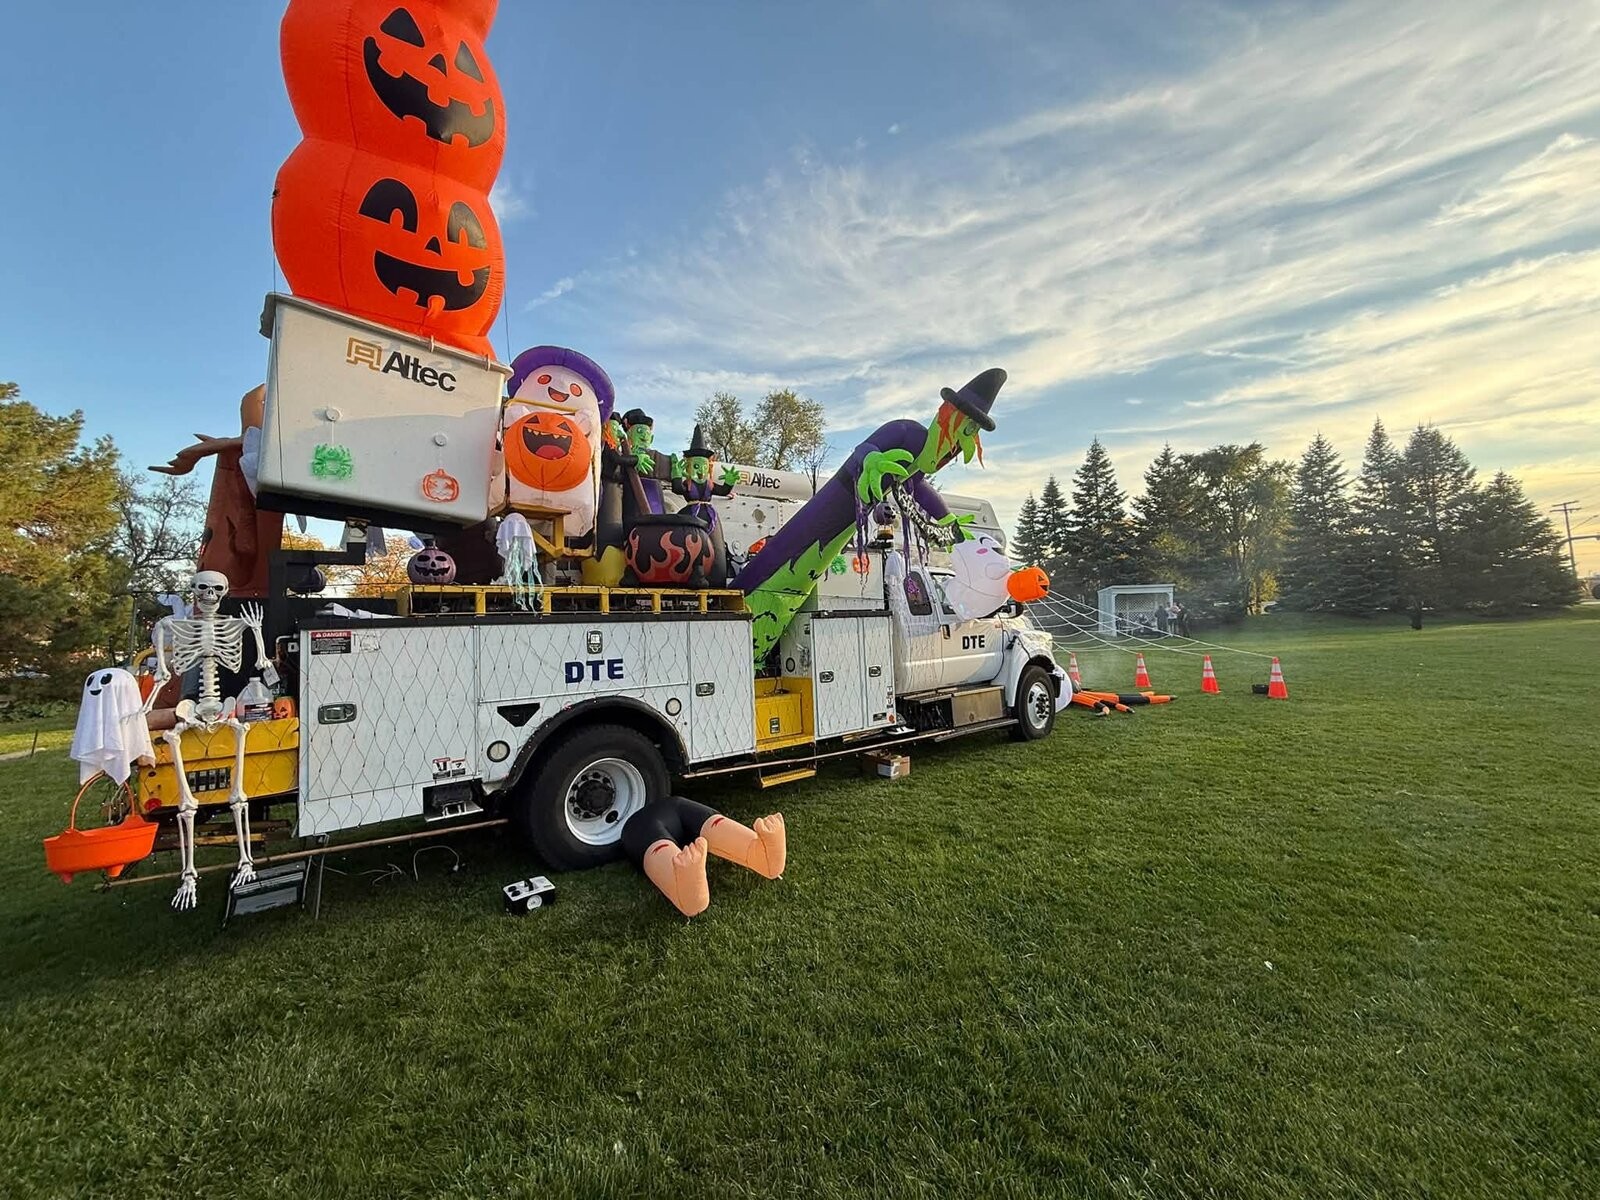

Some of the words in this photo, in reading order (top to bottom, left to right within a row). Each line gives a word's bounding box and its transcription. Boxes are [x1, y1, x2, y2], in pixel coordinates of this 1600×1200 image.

[381, 351, 457, 392] Altec
[750, 473, 781, 489] Altec
[962, 635, 985, 650] DTE
[565, 659, 624, 684] DTE
